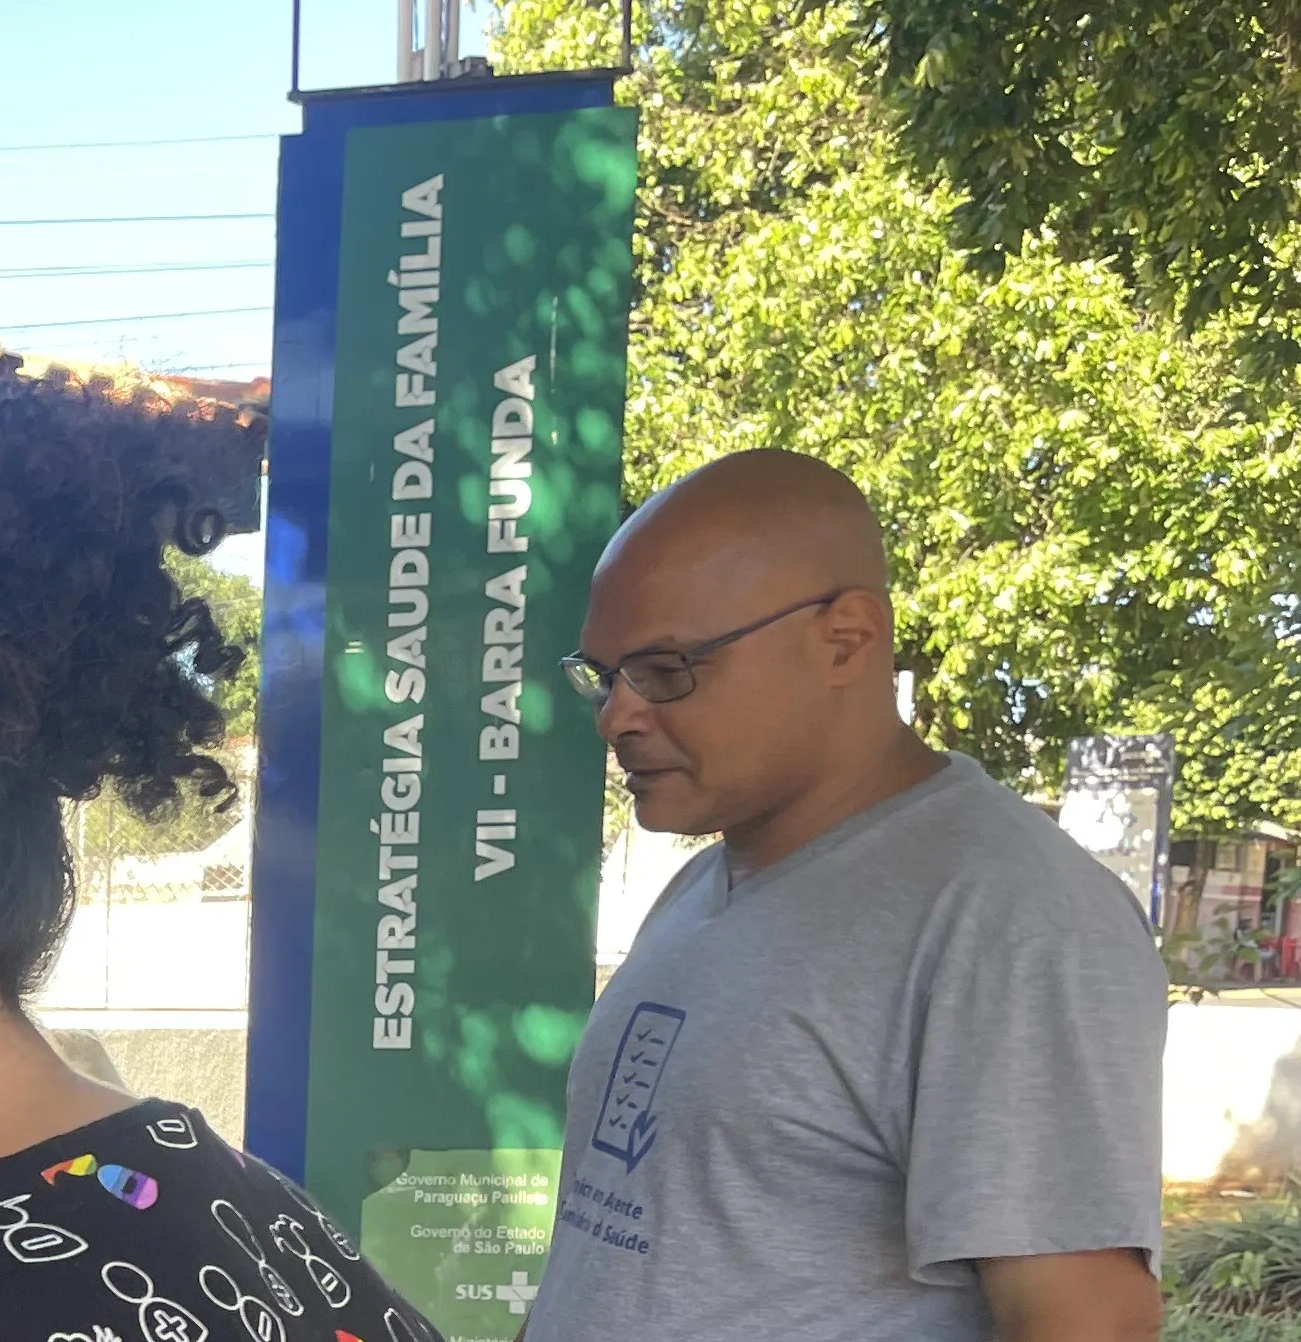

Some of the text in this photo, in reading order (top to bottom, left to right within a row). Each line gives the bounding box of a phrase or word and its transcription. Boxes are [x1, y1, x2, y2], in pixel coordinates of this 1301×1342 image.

[487, 354, 537, 553] FUNDA
[370, 173, 444, 1050] ESTRATÉGIA SAUDE DA FAMÍLIA
[479, 564, 527, 761] BARRA
[474, 809, 517, 882] VII
[396, 1172, 456, 1186] Governo
[460, 1173, 526, 1188] Municipal
[414, 1190, 488, 1207] Paraguaçu
[410, 1225, 546, 1239] Governo do Estado
[453, 1240, 545, 1255] de São Paulo
[455, 1284, 492, 1300] SUS
